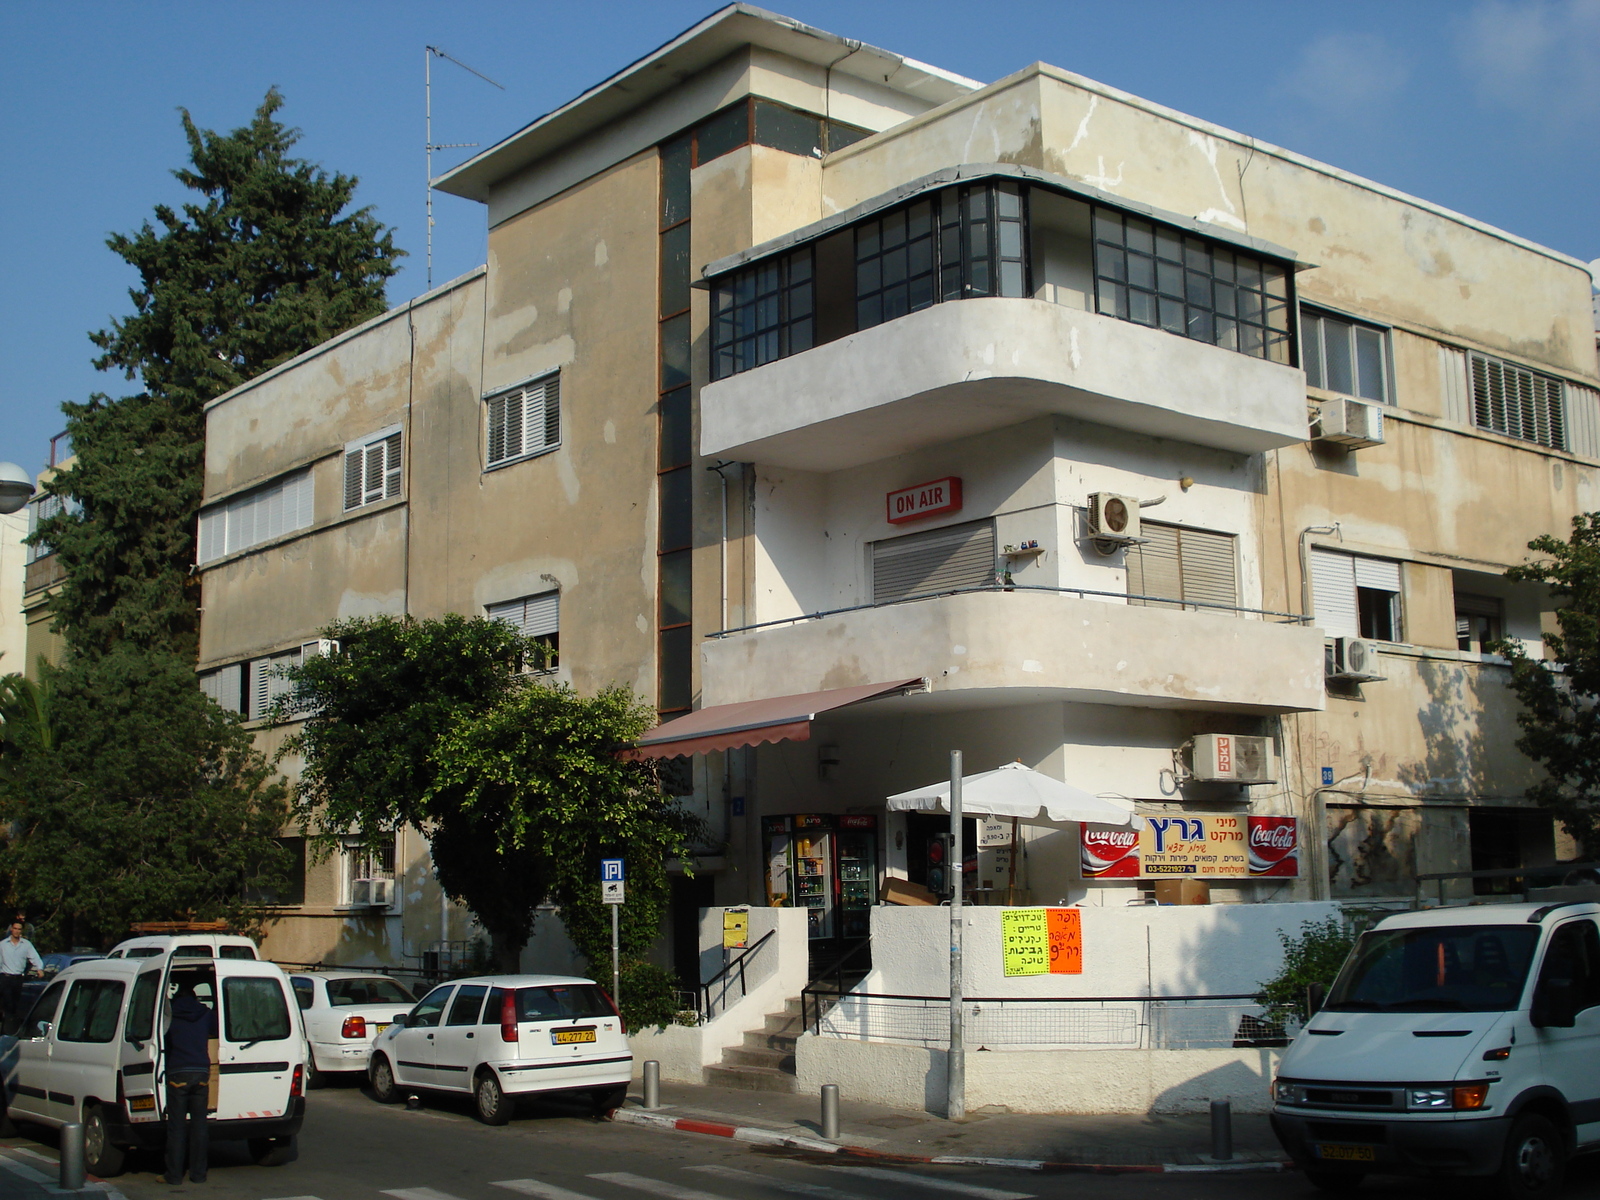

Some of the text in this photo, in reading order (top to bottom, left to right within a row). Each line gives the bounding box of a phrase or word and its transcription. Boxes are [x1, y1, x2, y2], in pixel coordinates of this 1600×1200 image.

[897, 487, 943, 513] ON AIR
[1322, 770, 1332, 780] 39
[1216, 818, 1237, 827] מיני
[1145, 817, 1205, 854] גרץ
[1210, 831, 1244, 843] מרקט
[1219, 865, 1245, 873] משלוחים
[1057, 913, 1077, 925] קפה
[1009, 936, 1041, 944] נקניקים
[1049, 931, 1076, 942] מאפה
[1066, 945, 1079, 959] רק
